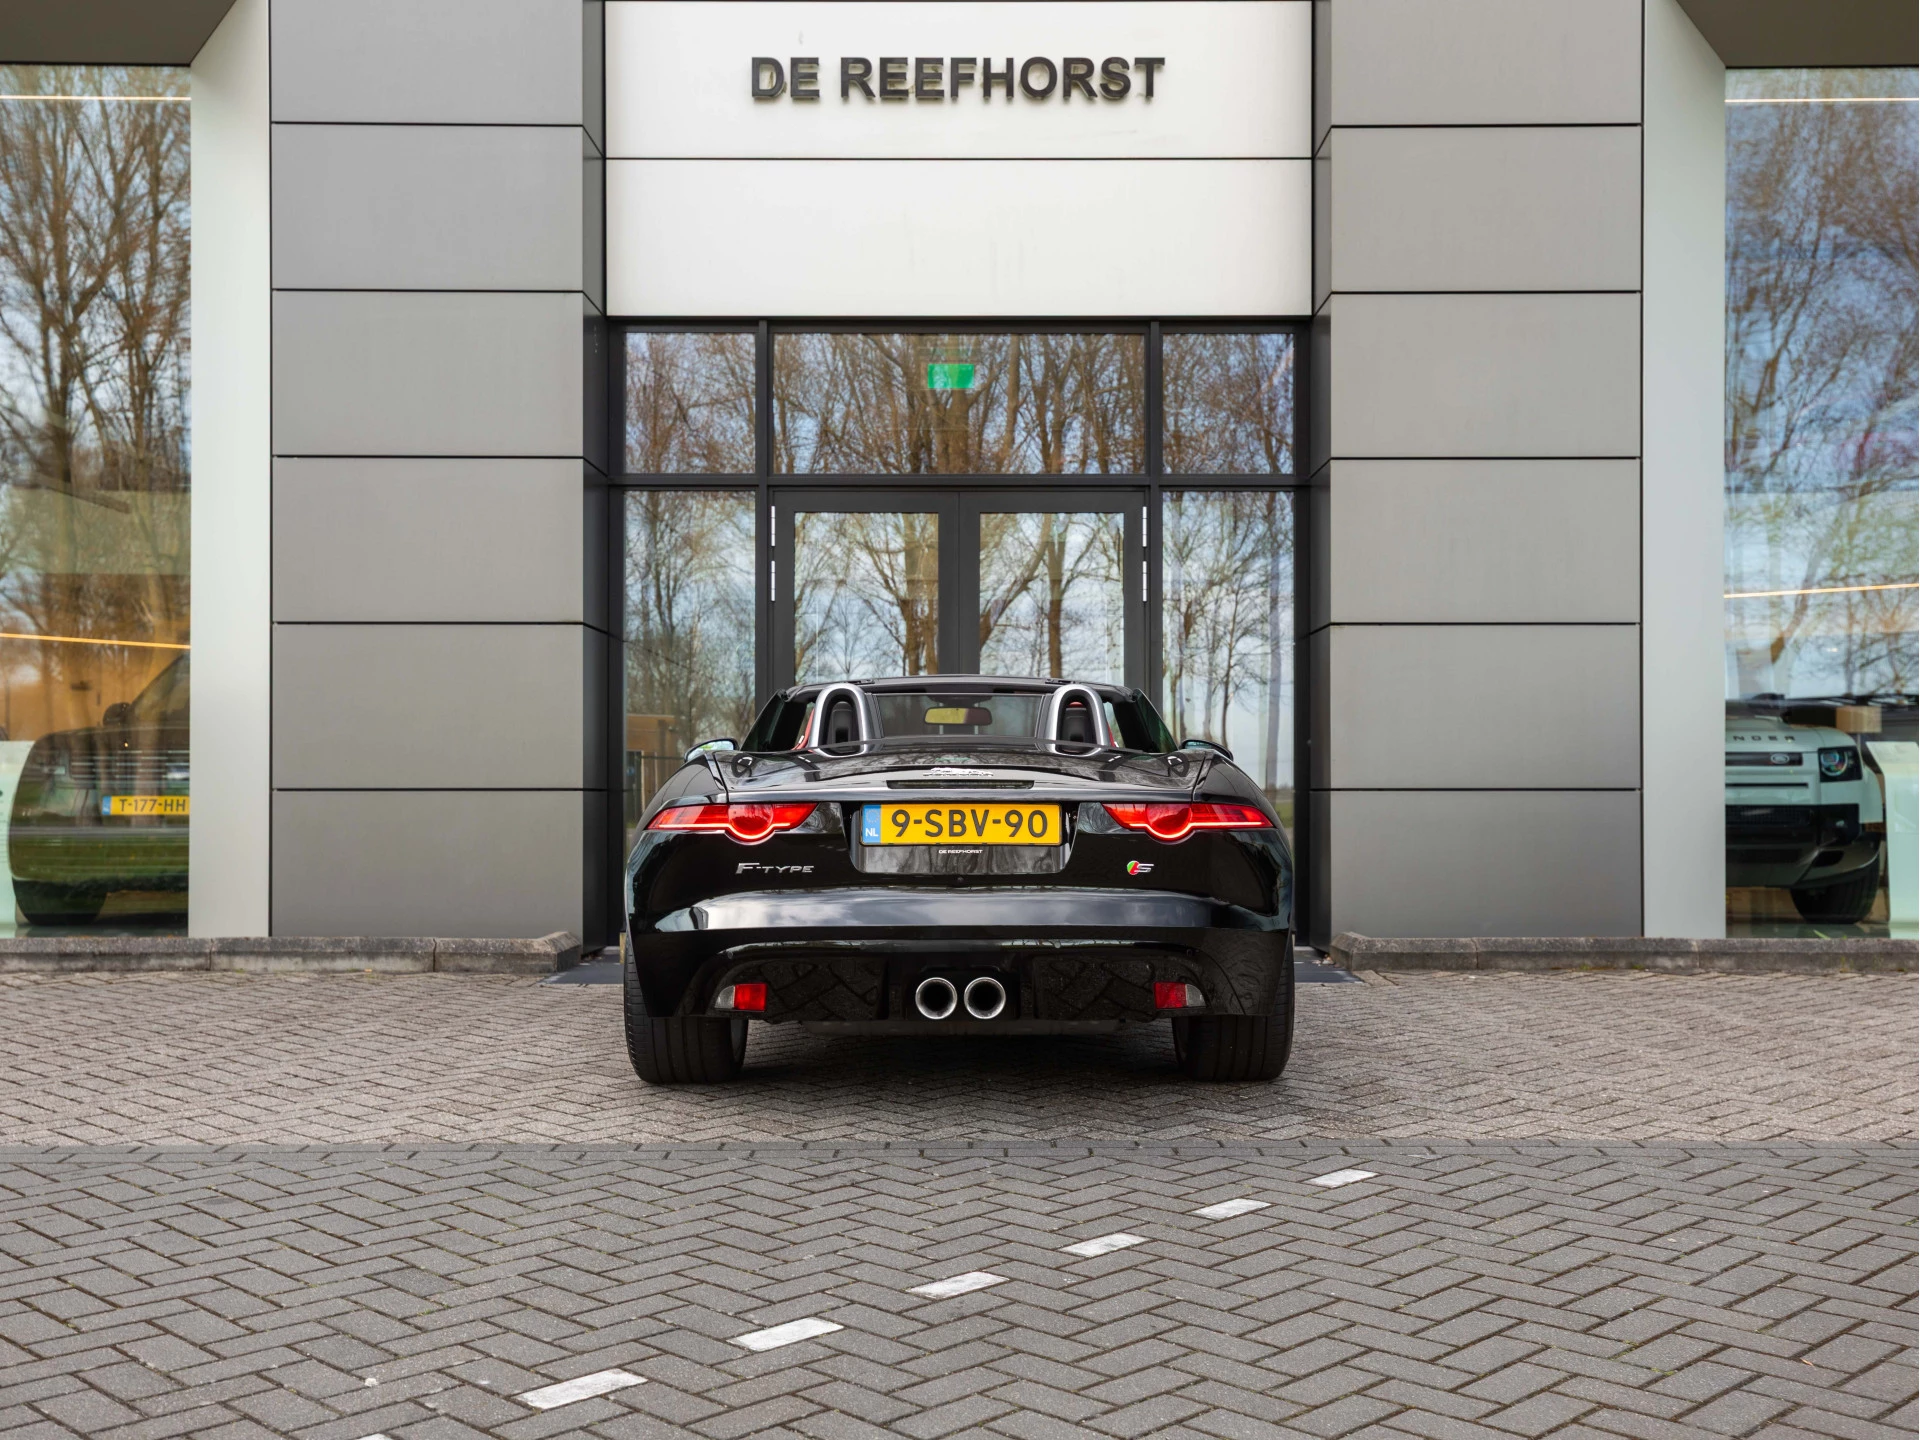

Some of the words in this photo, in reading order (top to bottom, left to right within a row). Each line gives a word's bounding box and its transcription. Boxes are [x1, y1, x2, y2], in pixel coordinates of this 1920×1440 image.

[751, 56, 820, 100] DE
[840, 56, 1165, 100] REEFHORST
[119, 798, 186, 813] T-177-HH
[891, 808, 1049, 838] 9-SBV-90
[865, 828, 879, 837] NL
[735, 862, 815, 874] F-TYPE
